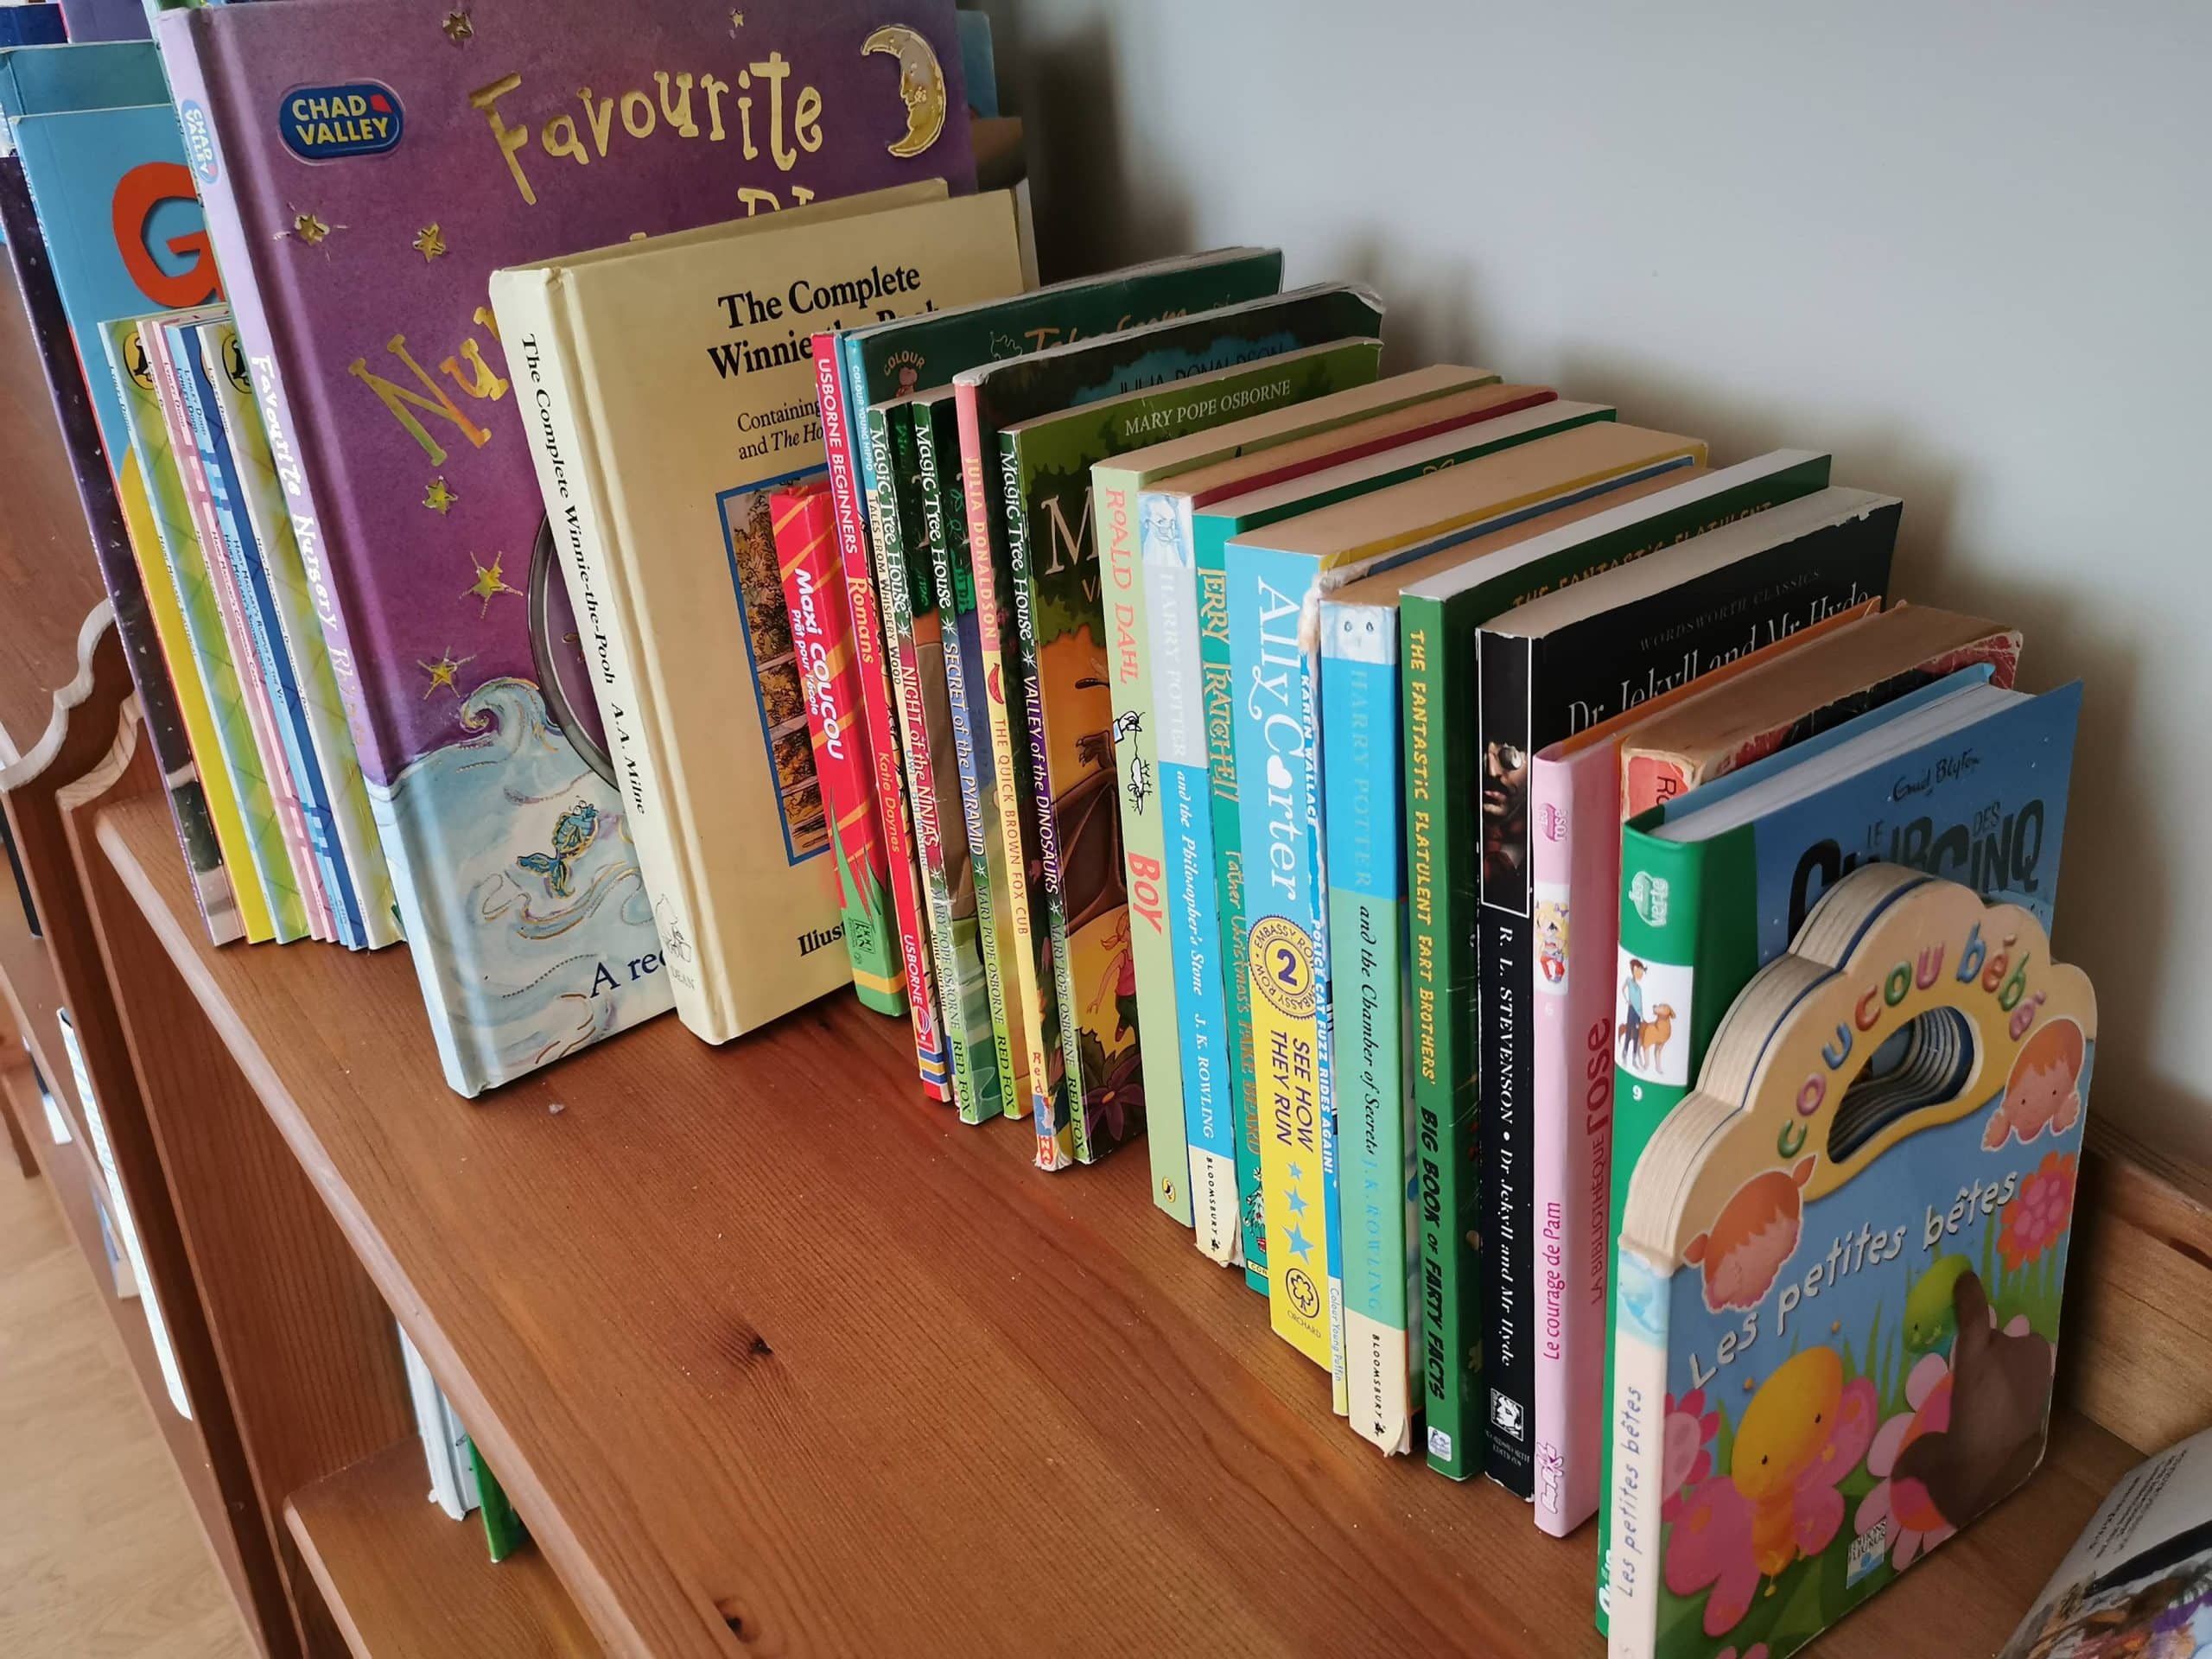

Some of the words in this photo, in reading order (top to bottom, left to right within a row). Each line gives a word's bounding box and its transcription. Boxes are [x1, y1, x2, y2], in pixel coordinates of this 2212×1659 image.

[189, 108, 214, 162] CHAD
[292, 95, 368, 122] CHAD
[296, 117, 390, 146] VALLEY
[470, 50, 823, 206] Favourite
[183, 110, 210, 175] VALLEY
[717, 289, 783, 329] The
[788, 265, 922, 315] Complete
[851, 365, 866, 407] COLOUR
[883, 349, 926, 377] COLOUR
[1125, 408, 1173, 437] MARY
[1176, 398, 1217, 424] POPE
[1219, 378, 1292, 413] OSBORNE
[738, 435, 769, 461] and
[770, 429, 800, 451] The
[817, 358, 842, 447] USBORNE
[830, 451, 861, 556] BEGINNERS
[869, 427, 892, 495] Magic
[915, 423, 937, 492] Magic
[251, 354, 303, 499] Favourite
[293, 512, 340, 632] Nursery
[868, 496, 881, 534] TALES
[964, 456, 983, 512] JULIA
[1000, 450, 1023, 520] Magic
[880, 496, 897, 546] Tree
[925, 493, 943, 543] Tree
[1007, 522, 1025, 571] Tree
[1104, 486, 1134, 591] ROALD
[520, 332, 542, 383] The
[535, 388, 571, 499] Complete
[564, 504, 615, 686] Winnie-the-Pooh
[624, 761, 646, 817] Milne
[873, 536, 886, 573] FROM
[887, 551, 908, 613] House
[931, 546, 952, 610] House
[972, 521, 996, 639] DONALDSON
[848, 576, 874, 664] Romans
[879, 577, 898, 642] WHISPERY
[1013, 577, 1033, 641] House
[1160, 570, 1181, 660] HARRY
[1639, 599, 1749, 654] WORDSWORTH
[1751, 568, 1821, 608] CLASSICS
[794, 568, 823, 636] Maxi
[810, 642, 844, 761] COUCOU
[888, 645, 902, 685] WOOD
[1114, 601, 1139, 686] DAHL
[1248, 575, 1300, 721] Ally
[1409, 629, 1426, 672] THE
[901, 664, 924, 728] NIGHT
[942, 641, 969, 712] SECRET
[1022, 675, 1044, 740] VALLEY
[994, 718, 1009, 747] THE
[1166, 668, 1188, 759] POTTER
[1300, 674, 1314, 745] KAREN
[1351, 669, 1370, 772] HARRY
[912, 751, 931, 782] the
[957, 739, 974, 769] the
[999, 754, 1015, 803] QUICK
[1033, 764, 1049, 792] the
[1891, 769, 1934, 804] Enid
[1935, 747, 1980, 785] Blyton
[877, 751, 891, 792] Katie
[884, 795, 900, 854] Daynes
[918, 785, 939, 849] NINJAS
[961, 775, 985, 858] PYRAMID
[1176, 770, 1192, 802] and
[1303, 746, 1318, 827] WALLACE
[1004, 810, 1021, 866] BROWN
[1036, 796, 1059, 896] DINOSAURS
[1354, 778, 1373, 888] POTTER
[1866, 818, 1885, 849] LE
[1972, 800, 2001, 838] DES
[1012, 871, 1024, 900] FOX
[1127, 850, 1164, 936] BOY
[1181, 833, 1204, 948] Philosopher's
[1414, 810, 1432, 927] FLATULENT
[977, 884, 993, 922] MARY
[1015, 906, 1029, 936] CUB
[1359, 906, 1377, 946] and
[1651, 877, 1669, 926] verte
[903, 934, 924, 1006] USBORNE
[983, 925, 996, 963] POPE
[1051, 922, 1066, 962] MARY
[1189, 950, 1205, 996] Stone
[1276, 948, 1298, 987] 2
[1311, 918, 1324, 976] POLICE
[1418, 934, 1433, 984] FART
[987, 963, 1005, 1026] OSBORNE
[1055, 962, 1069, 1000] POPE
[1315, 982, 1326, 1014] CAT
[1058, 1001, 1077, 1068] OSBORNE
[1317, 1020, 1329, 1062] FUZZ
[1361, 983, 1380, 1067] Chamber
[1499, 986, 1513, 1125] STEVENSON
[1777, 940, 1945, 1160] coucou
[1955, 920, 2047, 1042] bébé
[952, 1039, 966, 1076] RED
[959, 1079, 973, 1116] FOX
[996, 1034, 1010, 1071] RED
[1003, 1074, 1016, 1114] FOX
[1270, 1029, 1291, 1091] THEY
[1293, 1037, 1312, 1083] SEE
[1319, 1067, 1332, 1113] RIDES
[1586, 1017, 1612, 1137] rose
[1067, 1077, 1081, 1115] RED
[1198, 1055, 1215, 1139] ROWLING
[1274, 1092, 1294, 1147] RUN
[1294, 1085, 1314, 1154] HOW
[1363, 1092, 1381, 1155] Secrets
[1072, 1116, 1086, 1155] FOX
[1321, 1116, 1334, 1175] AGAIN!
[1420, 1106, 1440, 1154] BIG
[1500, 1147, 1513, 1175] Dr
[1205, 1156, 1218, 1236] BLOOMSBURY
[1422, 1156, 1441, 1230] BOOK
[1497, 1177, 1514, 1241] Jekyll
[1543, 1201, 1561, 1241] Pam
[1365, 1204, 1382, 1311] ROWLING
[1499, 1245, 1514, 1286] and
[1543, 1241, 1560, 1267] de
[1688, 1312, 1759, 1389] Les
[1776, 1222, 1908, 1338] petites
[1921, 1170, 2018, 1252] bêtes
[1287, 1309, 1322, 1339] ORCHARD
[1330, 1287, 1341, 1323] Colour
[1424, 1255, 1444, 1332] FARTY
[1500, 1286, 1514, 1316] Mr
[1544, 1271, 1566, 1338] courage
[1427, 1332, 1446, 1402] FACTS
[1497, 1319, 1515, 1368] Hyde
[1371, 1332, 1384, 1420] BLOOMSBURY
[1620, 1385, 1643, 1455] bêtes
[1618, 1463, 1643, 1556] petites
[1617, 1557, 1636, 1598] Les
